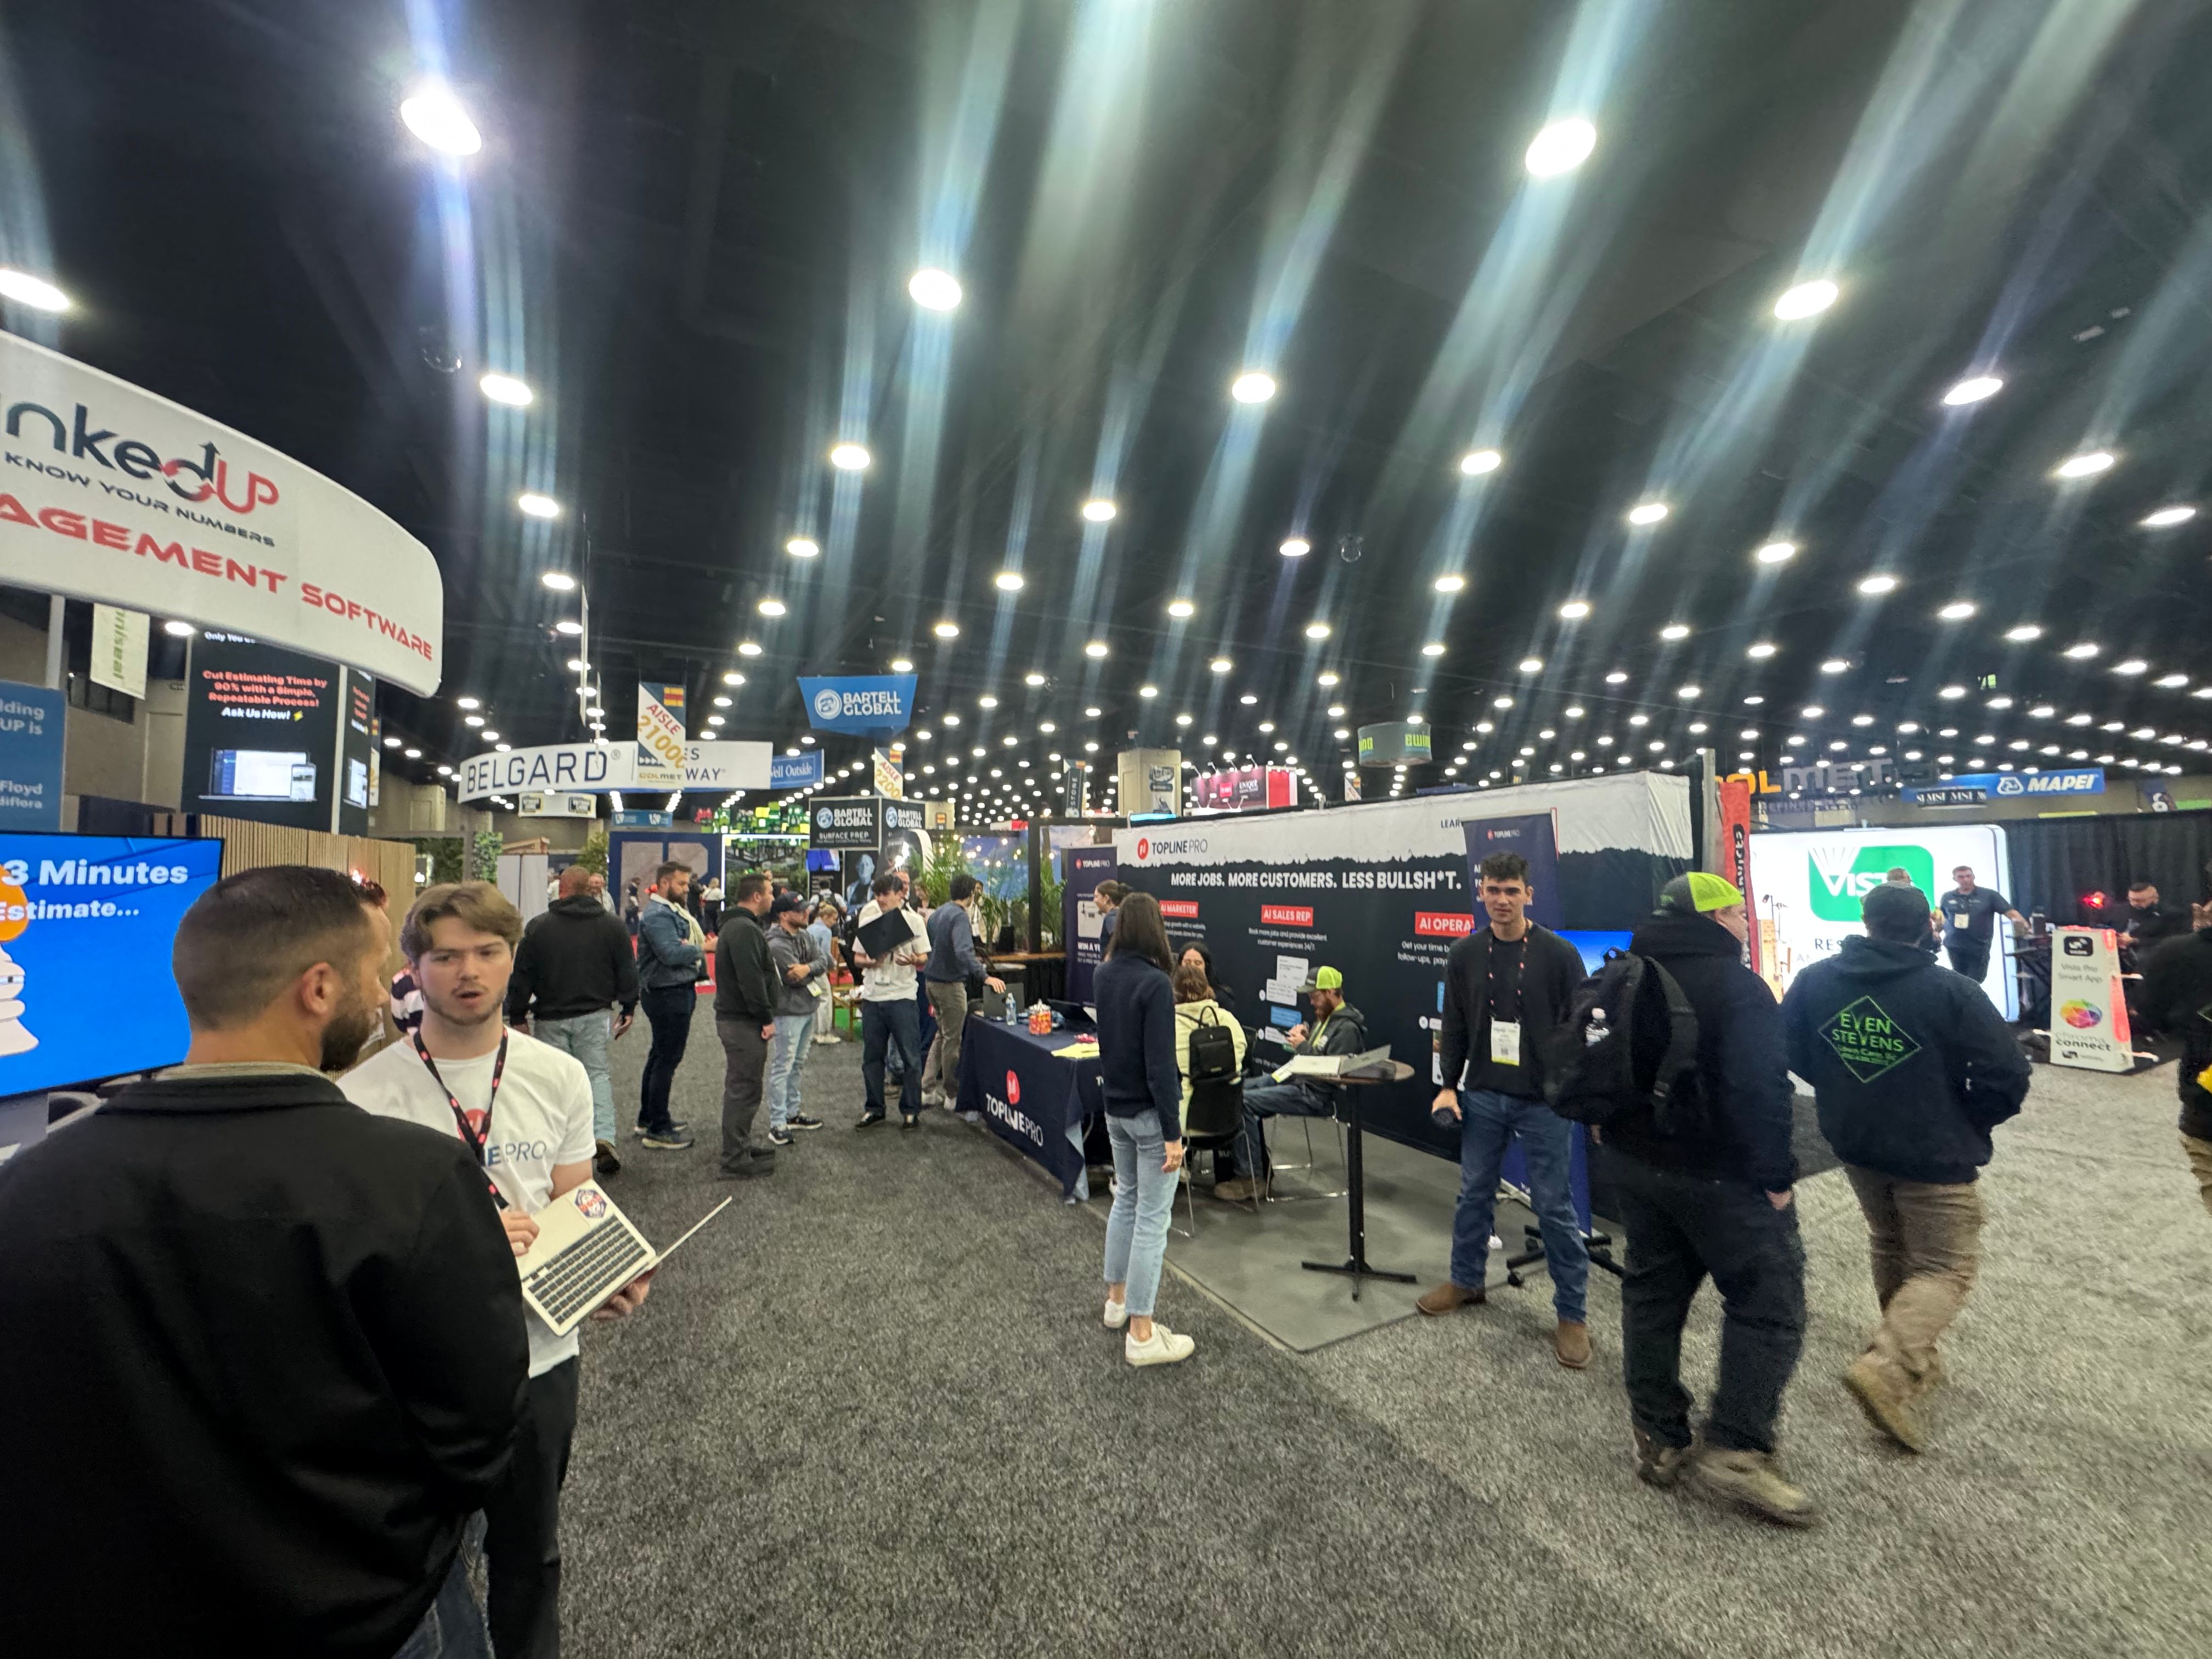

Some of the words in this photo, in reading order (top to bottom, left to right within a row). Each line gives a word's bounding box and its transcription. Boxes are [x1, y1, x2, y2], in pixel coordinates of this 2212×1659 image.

[4, 451, 91, 487] KNOW
[98, 480, 171, 514] YOUR
[176, 506, 275, 547] NUMBERS
[301, 582, 433, 662] SOFTWARE
[202, 670, 223, 680] Cut
[225, 671, 284, 686] Estimating
[286, 675, 313, 686] Time
[314, 678, 328, 689] by
[242, 684, 267, 694] with
[208, 692, 271, 705] Repeatable
[843, 691, 901, 704] BARTELL
[222, 707, 244, 717] Ask
[246, 708, 261, 718] Us
[262, 709, 291, 720] Now!
[843, 702, 902, 716] GLOBAL
[646, 703, 681, 735] AISLE
[467, 751, 607, 794] BELGARD
[785, 761, 812, 777] Outside
[879, 761, 900, 781] AISLE
[2027, 774, 2095, 792] MAPEI
[834, 807, 873, 817] BARTELL
[898, 809, 922, 821] BARTELL
[834, 816, 873, 827] GLOBAL
[898, 818, 923, 829] GLOBAL
[3, 859, 29, 886] 3
[39, 859, 188, 885] Minutes
[1171, 873, 1196, 887] MORE
[1197, 873, 1225, 887] JOBS.
[1228, 872, 1258, 888] MORE
[1260, 872, 1337, 888] CUSTOMERS.
[1342, 871, 1374, 889] LESS
[1263, 909, 1272, 919] AI
[1273, 909, 1295, 921] SALES
[1296, 910, 1311, 922] REP
[1419, 918, 1431, 929] AI
[1433, 918, 1474, 932] OPERA
[2056, 1039, 2111, 1052] connect
